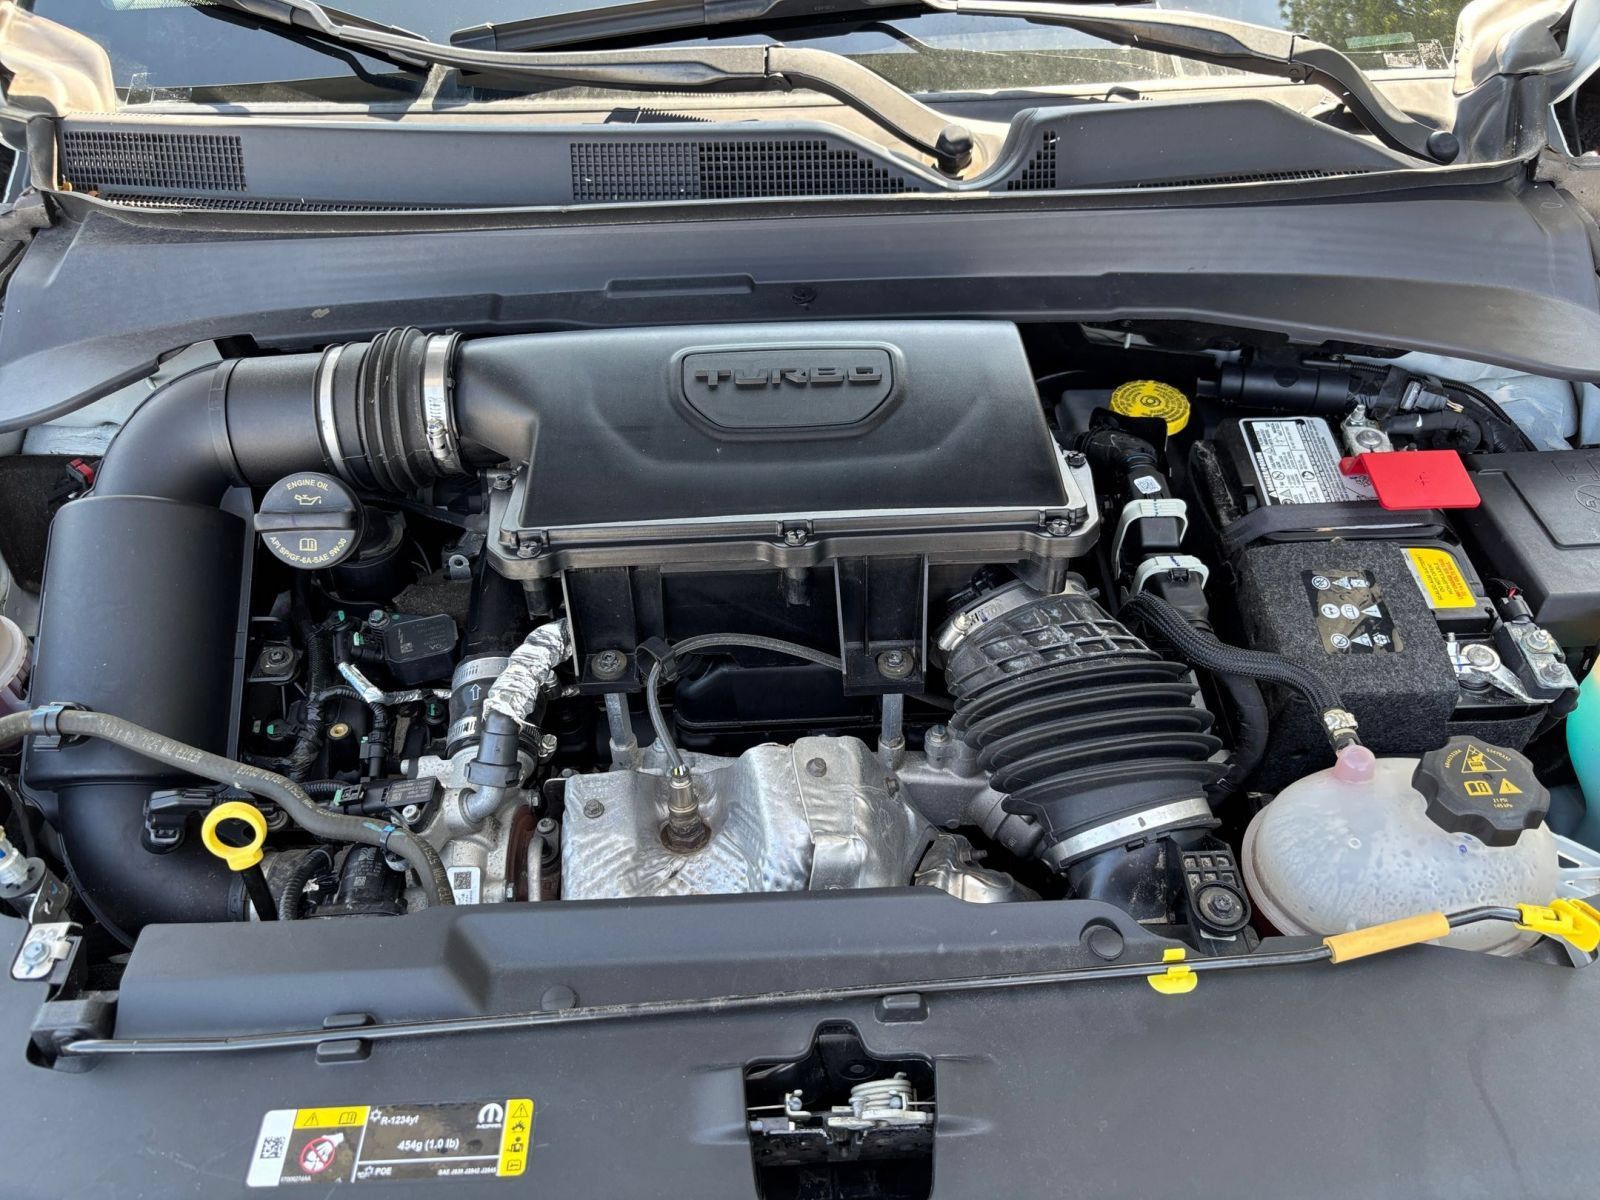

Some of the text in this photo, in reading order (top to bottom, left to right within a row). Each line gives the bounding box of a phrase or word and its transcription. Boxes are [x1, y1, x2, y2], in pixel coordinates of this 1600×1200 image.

[694, 366, 883, 387] TURBO
[286, 479, 329, 492] ENGINE OIL
[269, 536, 281, 549] API
[380, 1114, 420, 1126] R-1234yf
[397, 1137, 460, 1153] 454g (1.0 lb)
[374, 1165, 393, 1177] POE
